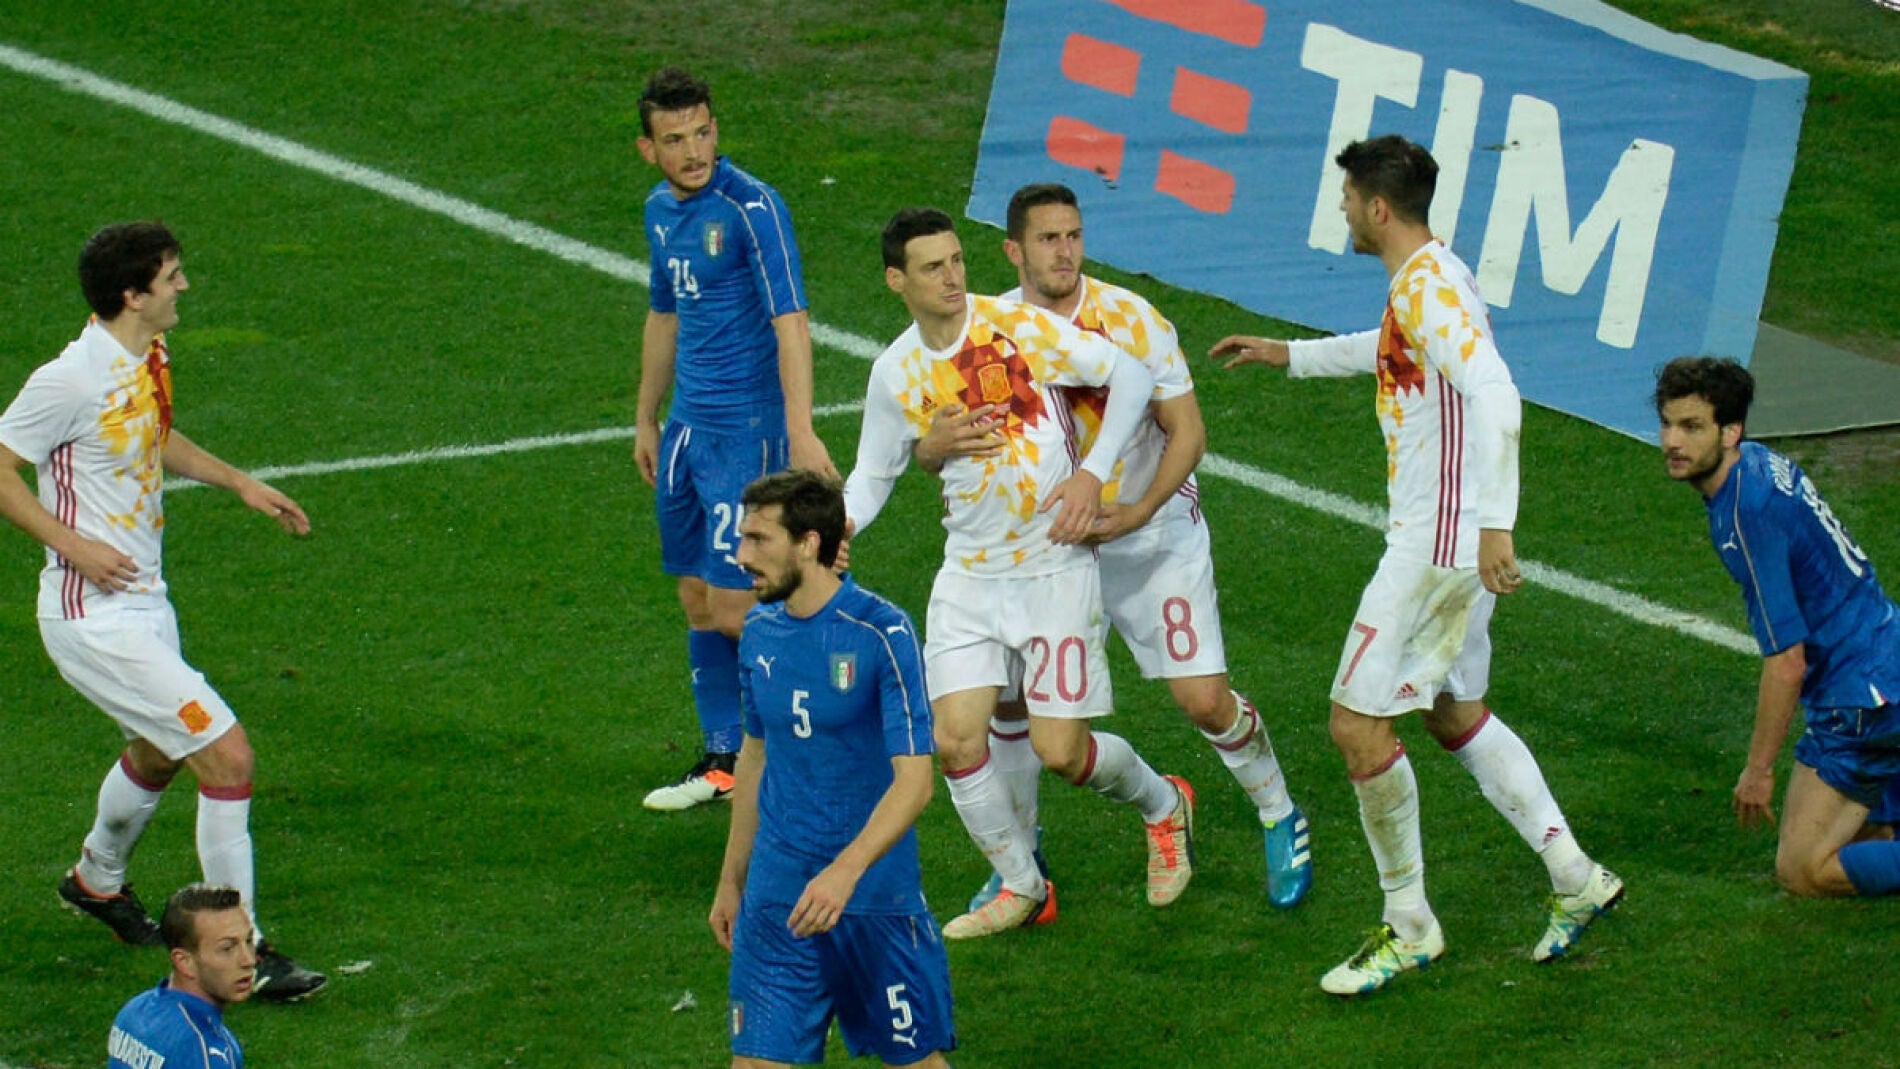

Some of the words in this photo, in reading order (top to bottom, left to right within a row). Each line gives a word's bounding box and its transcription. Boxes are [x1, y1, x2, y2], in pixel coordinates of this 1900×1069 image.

[1301, 22, 1675, 349] TIM
[667, 257, 701, 299] 24
[1162, 596, 1198, 662] 8
[1341, 623, 1377, 687] 7
[1026, 636, 1088, 702] 20
[793, 690, 811, 738] 5
[886, 984, 912, 1030] 5
